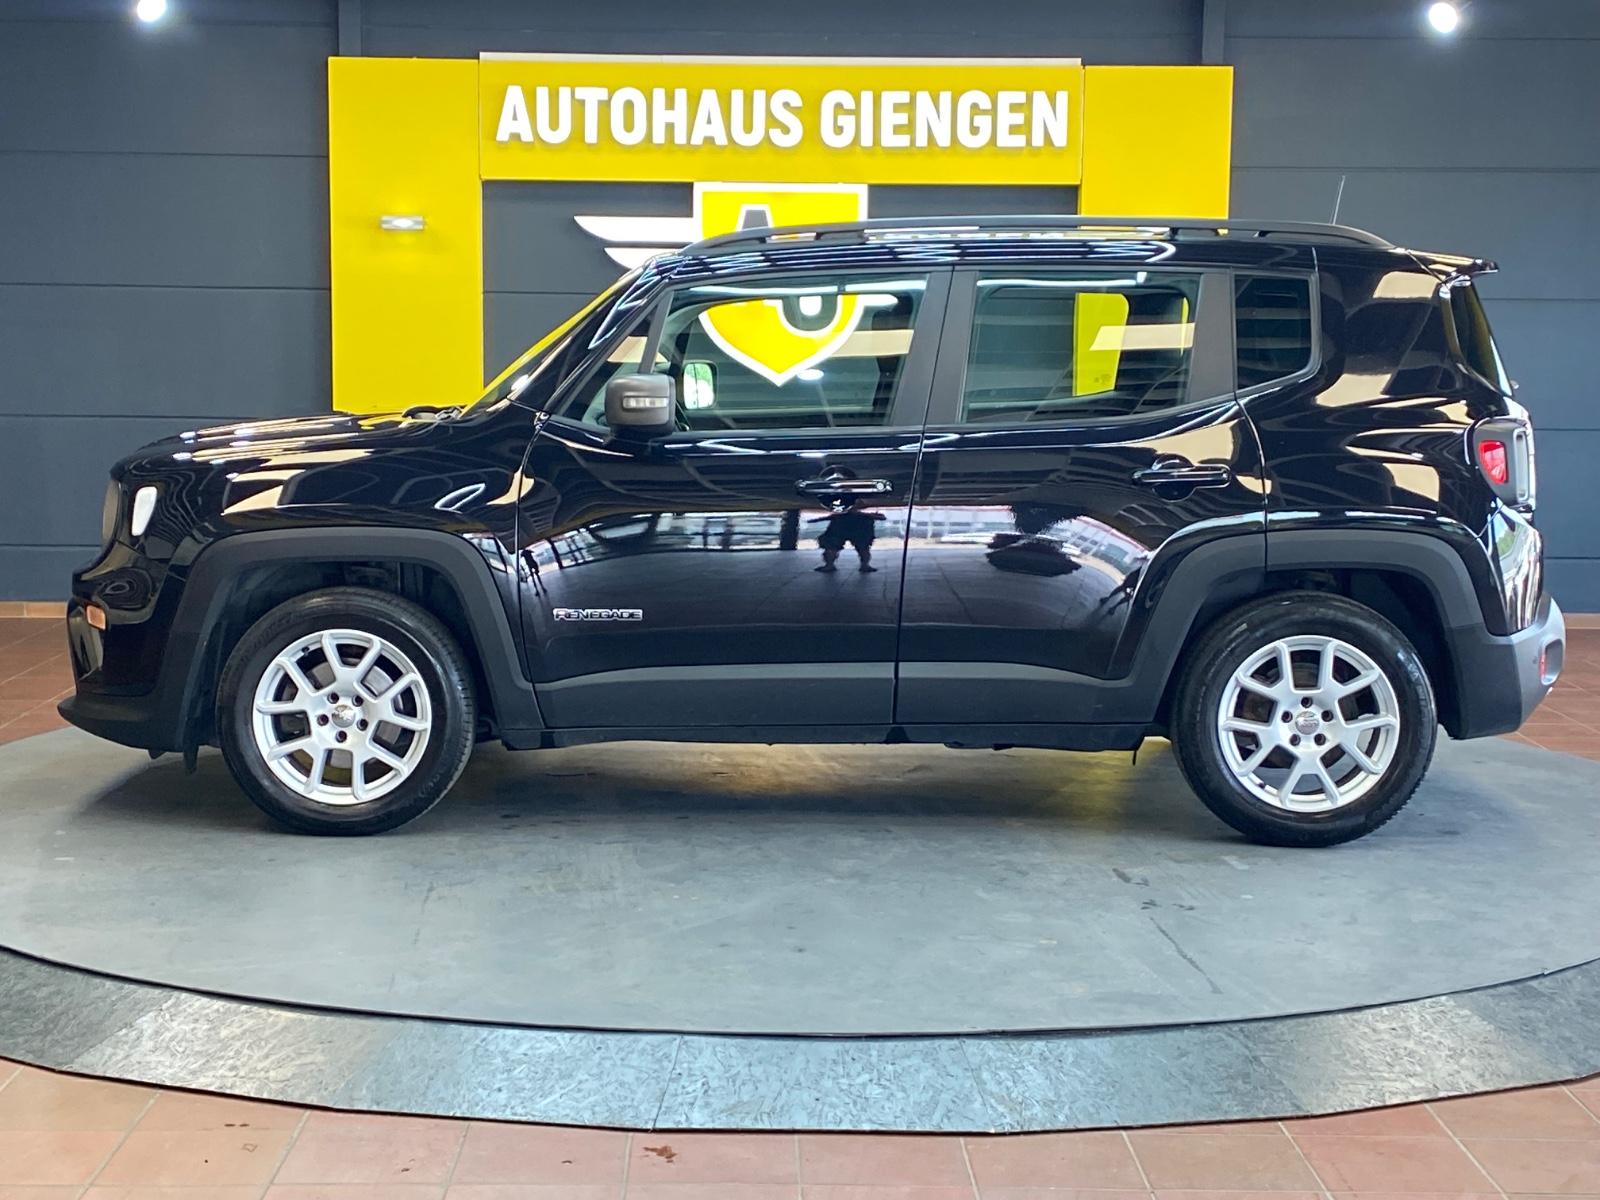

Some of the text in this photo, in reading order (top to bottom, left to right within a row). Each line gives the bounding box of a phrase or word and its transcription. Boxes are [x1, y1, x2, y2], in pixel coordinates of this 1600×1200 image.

[496, 85, 1069, 149] AUTOHAUS GIENGEN
[552, 608, 643, 621] RENEGADE
